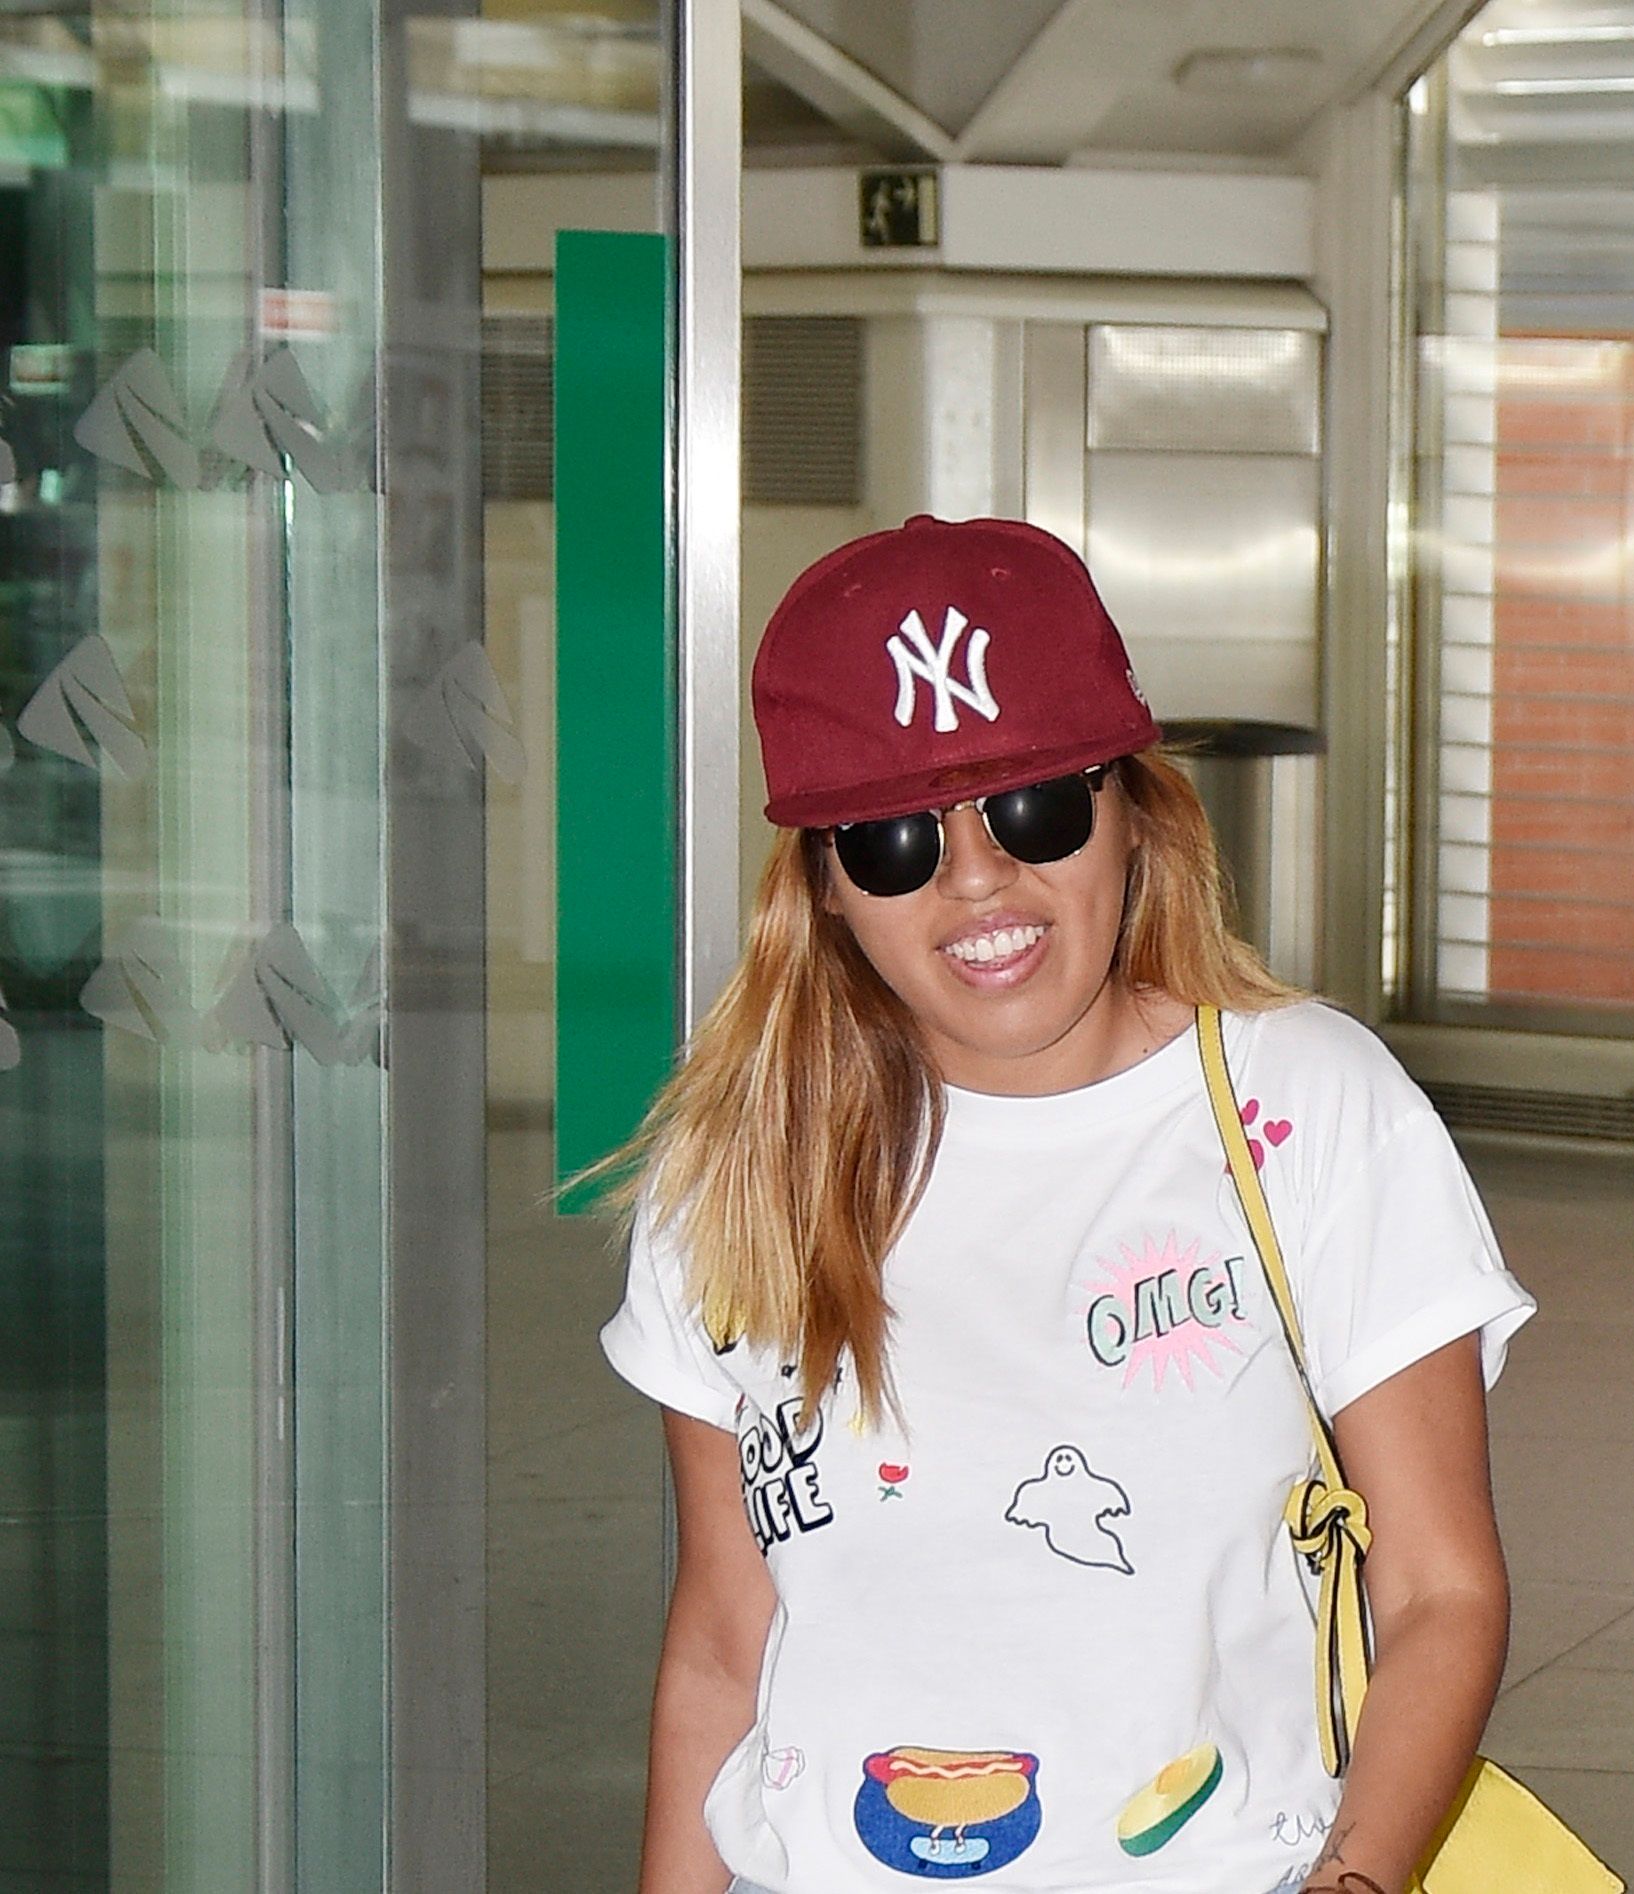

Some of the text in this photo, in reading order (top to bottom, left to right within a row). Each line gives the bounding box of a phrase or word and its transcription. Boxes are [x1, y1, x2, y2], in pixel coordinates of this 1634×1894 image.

[886, 605, 1000, 733] NY
[1087, 1256, 1248, 1367] OMG!
[745, 1463, 834, 1557] IFE
